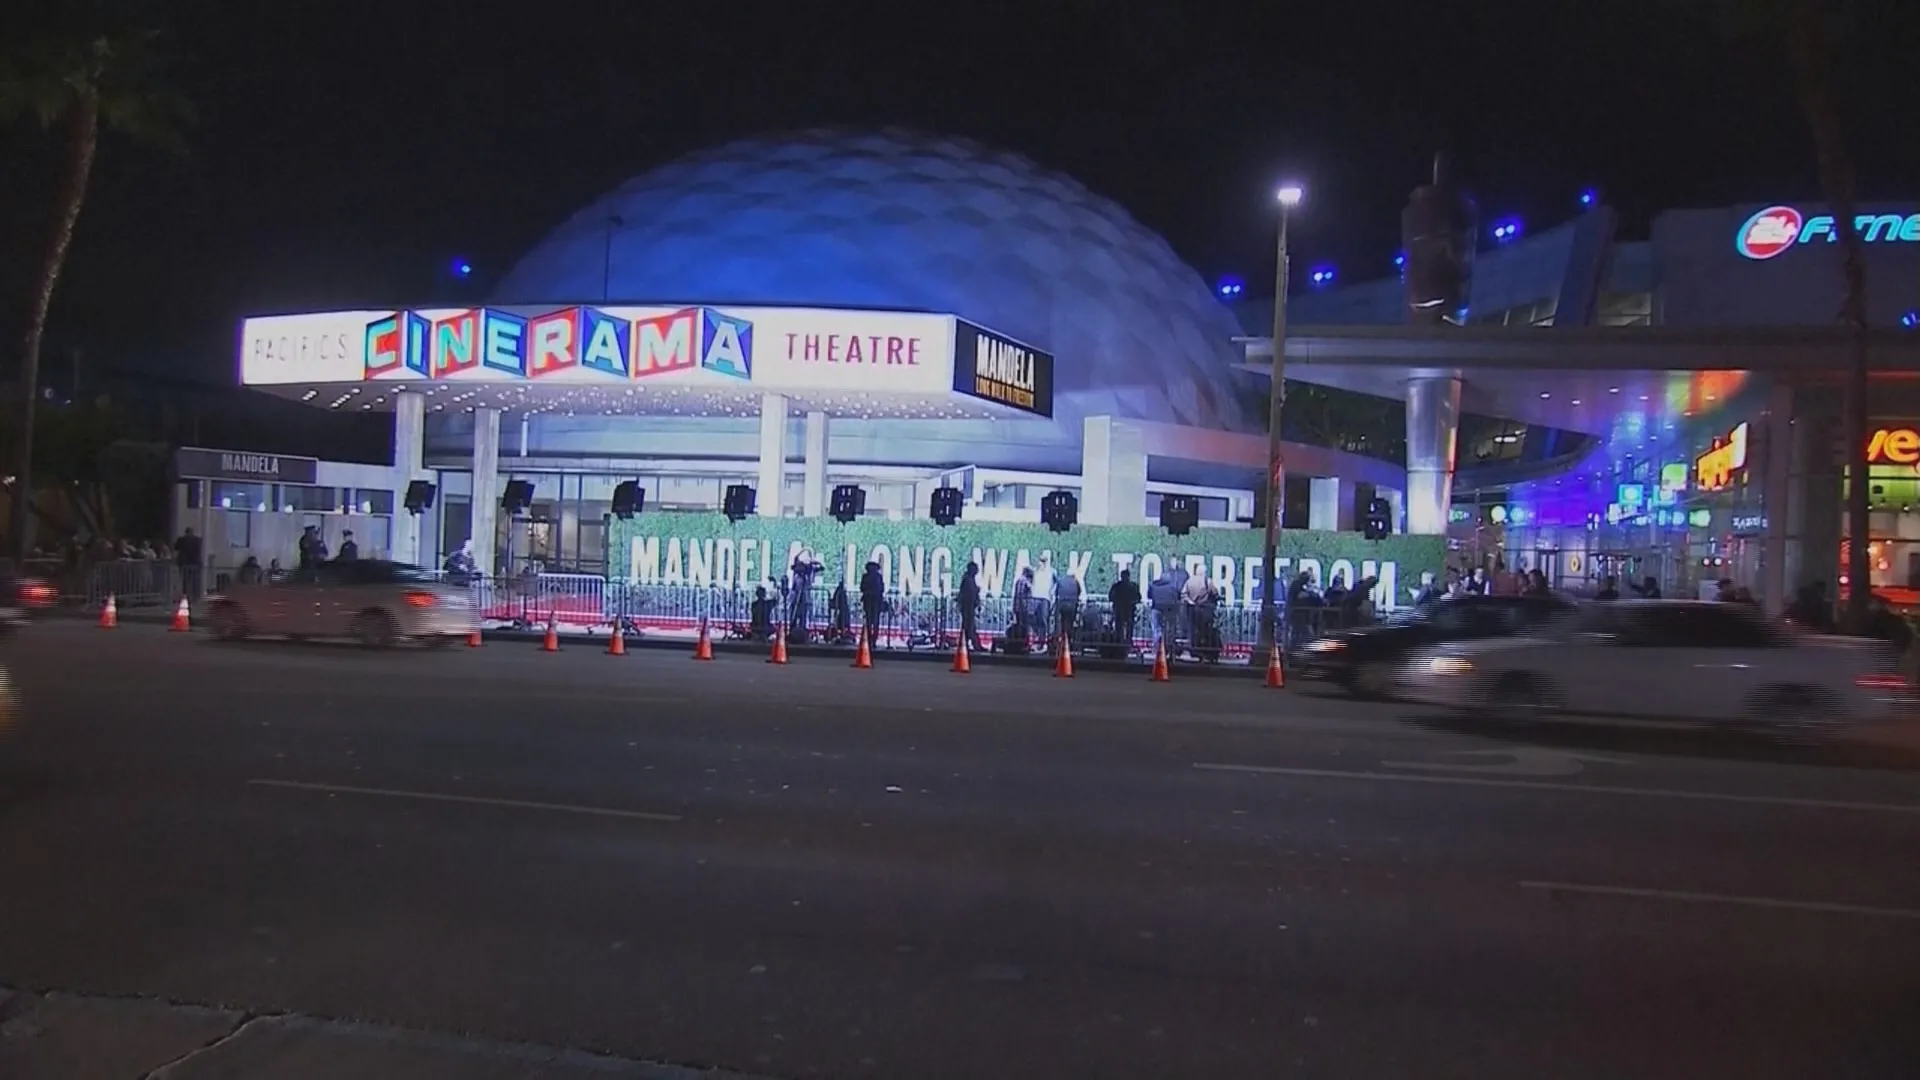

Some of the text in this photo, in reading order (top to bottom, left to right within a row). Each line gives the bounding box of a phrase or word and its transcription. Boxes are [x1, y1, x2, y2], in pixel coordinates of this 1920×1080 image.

[365, 317, 748, 371] CINERAMA
[785, 333, 921, 365] THEATRE
[976, 333, 1035, 392] MANDELA
[221, 454, 280, 474] MANDELA
[847, 543, 954, 598] LONG
[1112, 553, 1163, 605] TO
